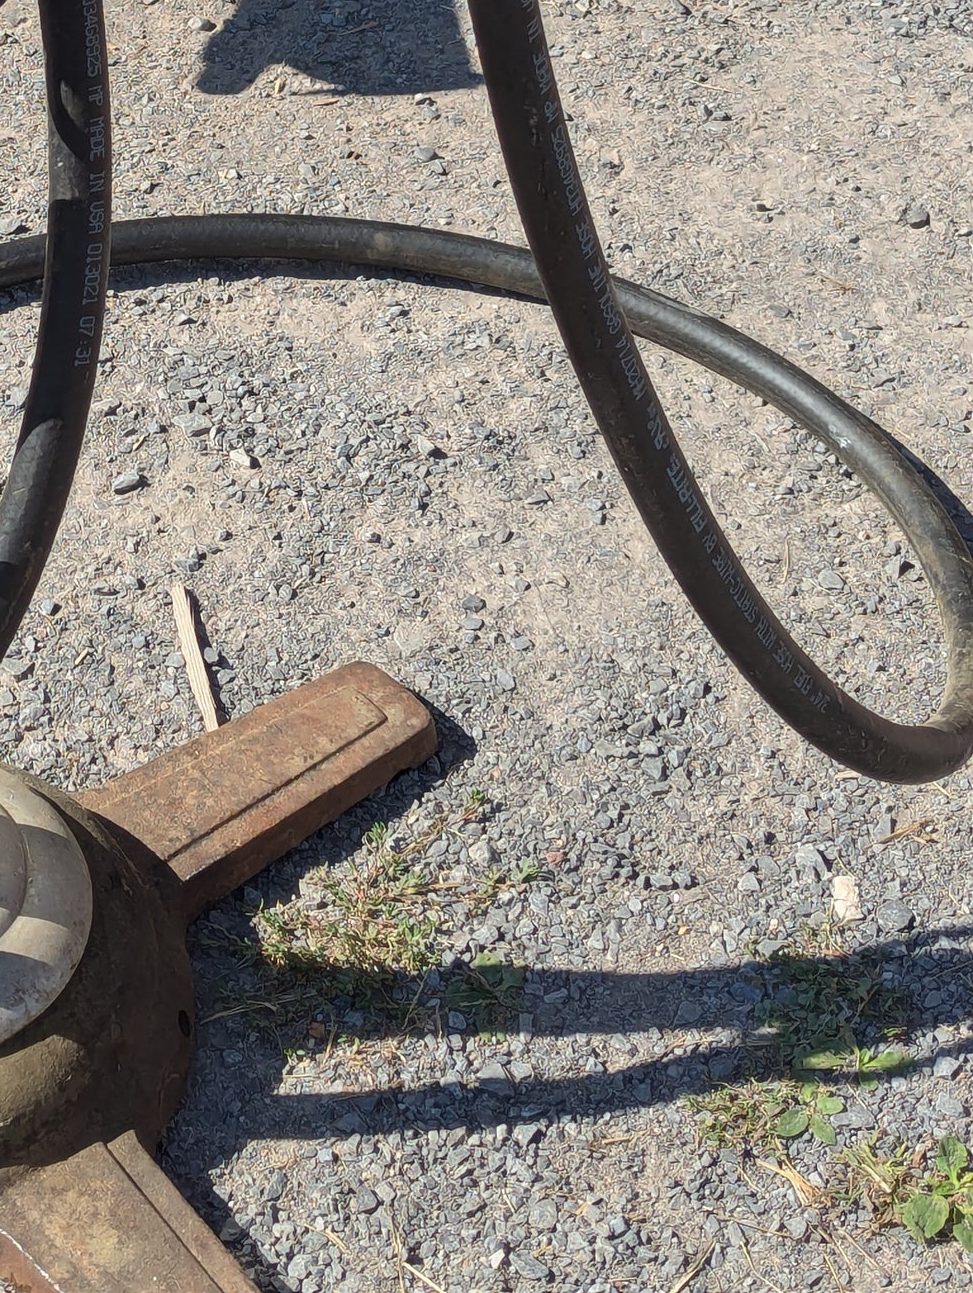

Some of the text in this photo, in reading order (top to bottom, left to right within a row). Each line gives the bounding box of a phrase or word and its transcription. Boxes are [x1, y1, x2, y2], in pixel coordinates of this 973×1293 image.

[526, 17, 539, 42] IN
[534, 49, 552, 94] MADE
[87, 85, 104, 107] MP
[545, 101, 559, 122] MP
[89, 117, 105, 162] MADE
[88, 171, 105, 193] IN
[89, 200, 104, 235] USA
[576, 218, 594, 260] HOSE
[81, 243, 103, 307] 013021
[588, 262, 621, 334] GASOLINE
[74, 315, 96, 368] 07:31
[702, 530, 717, 553] BY
[711, 546, 759, 624] STATIC-WIRE
[754, 616, 778, 650] WITH
[772, 640, 794, 675] HOSE
